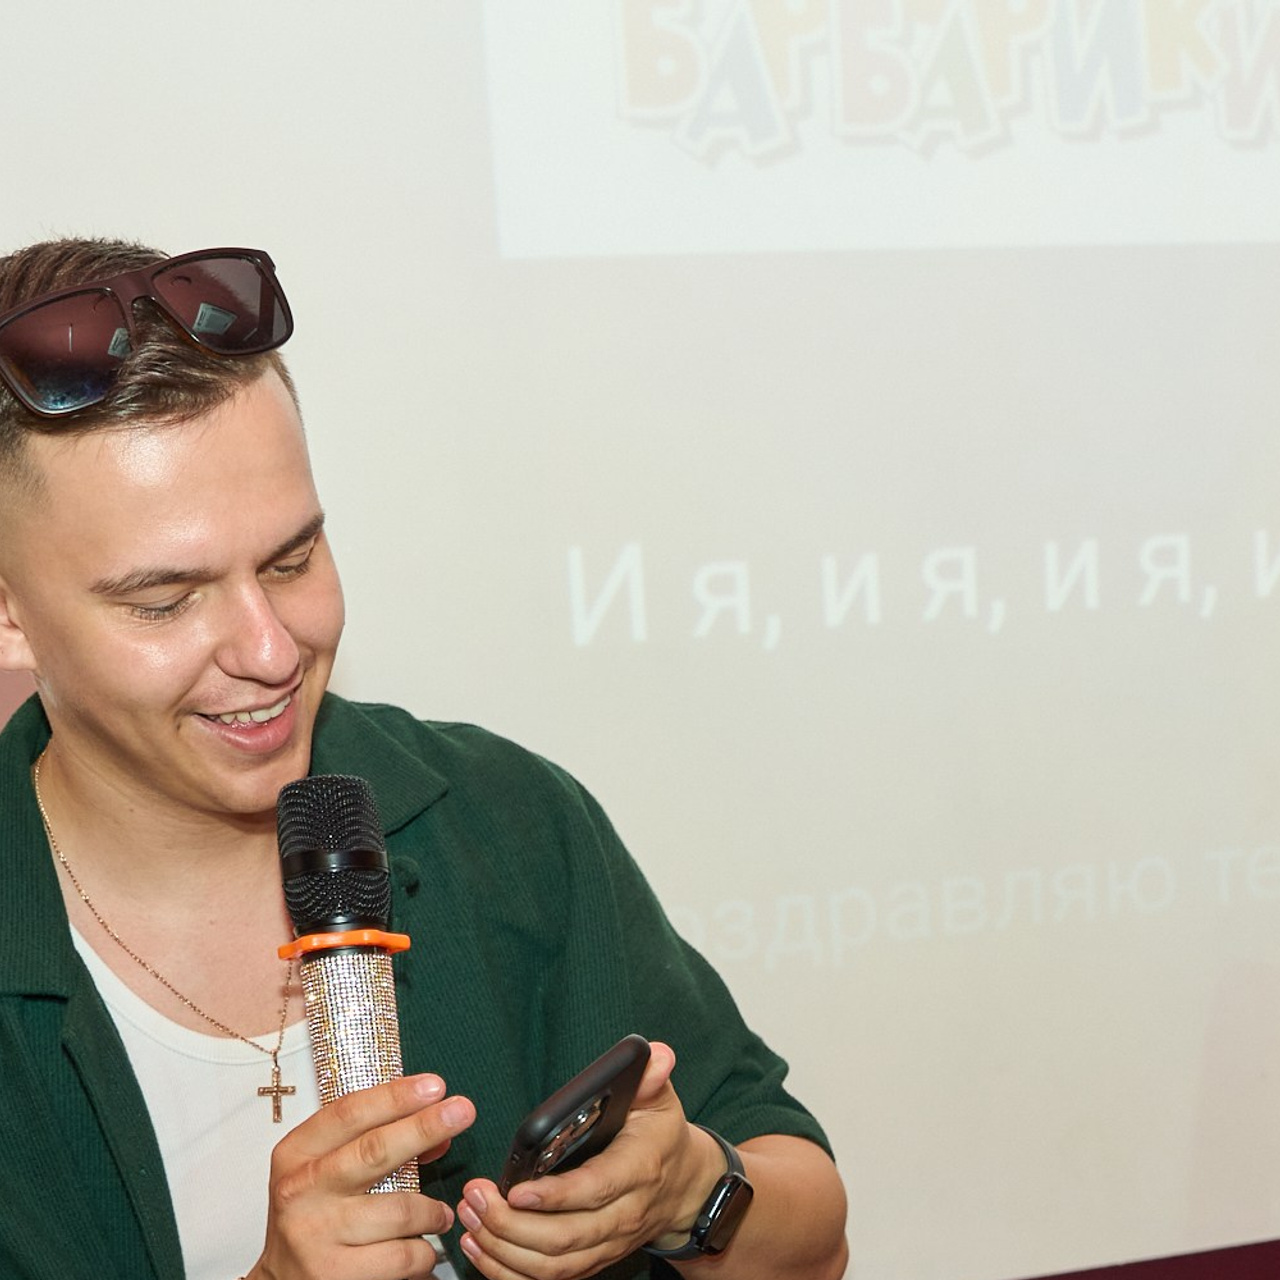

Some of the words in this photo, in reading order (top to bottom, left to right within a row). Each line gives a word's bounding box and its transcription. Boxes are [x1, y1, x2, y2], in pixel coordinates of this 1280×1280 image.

[566, 540, 649, 648] И
[820, 551, 883, 629] и
[1042, 536, 1101, 613] и
[668, 851, 1177, 972] оздравляю
